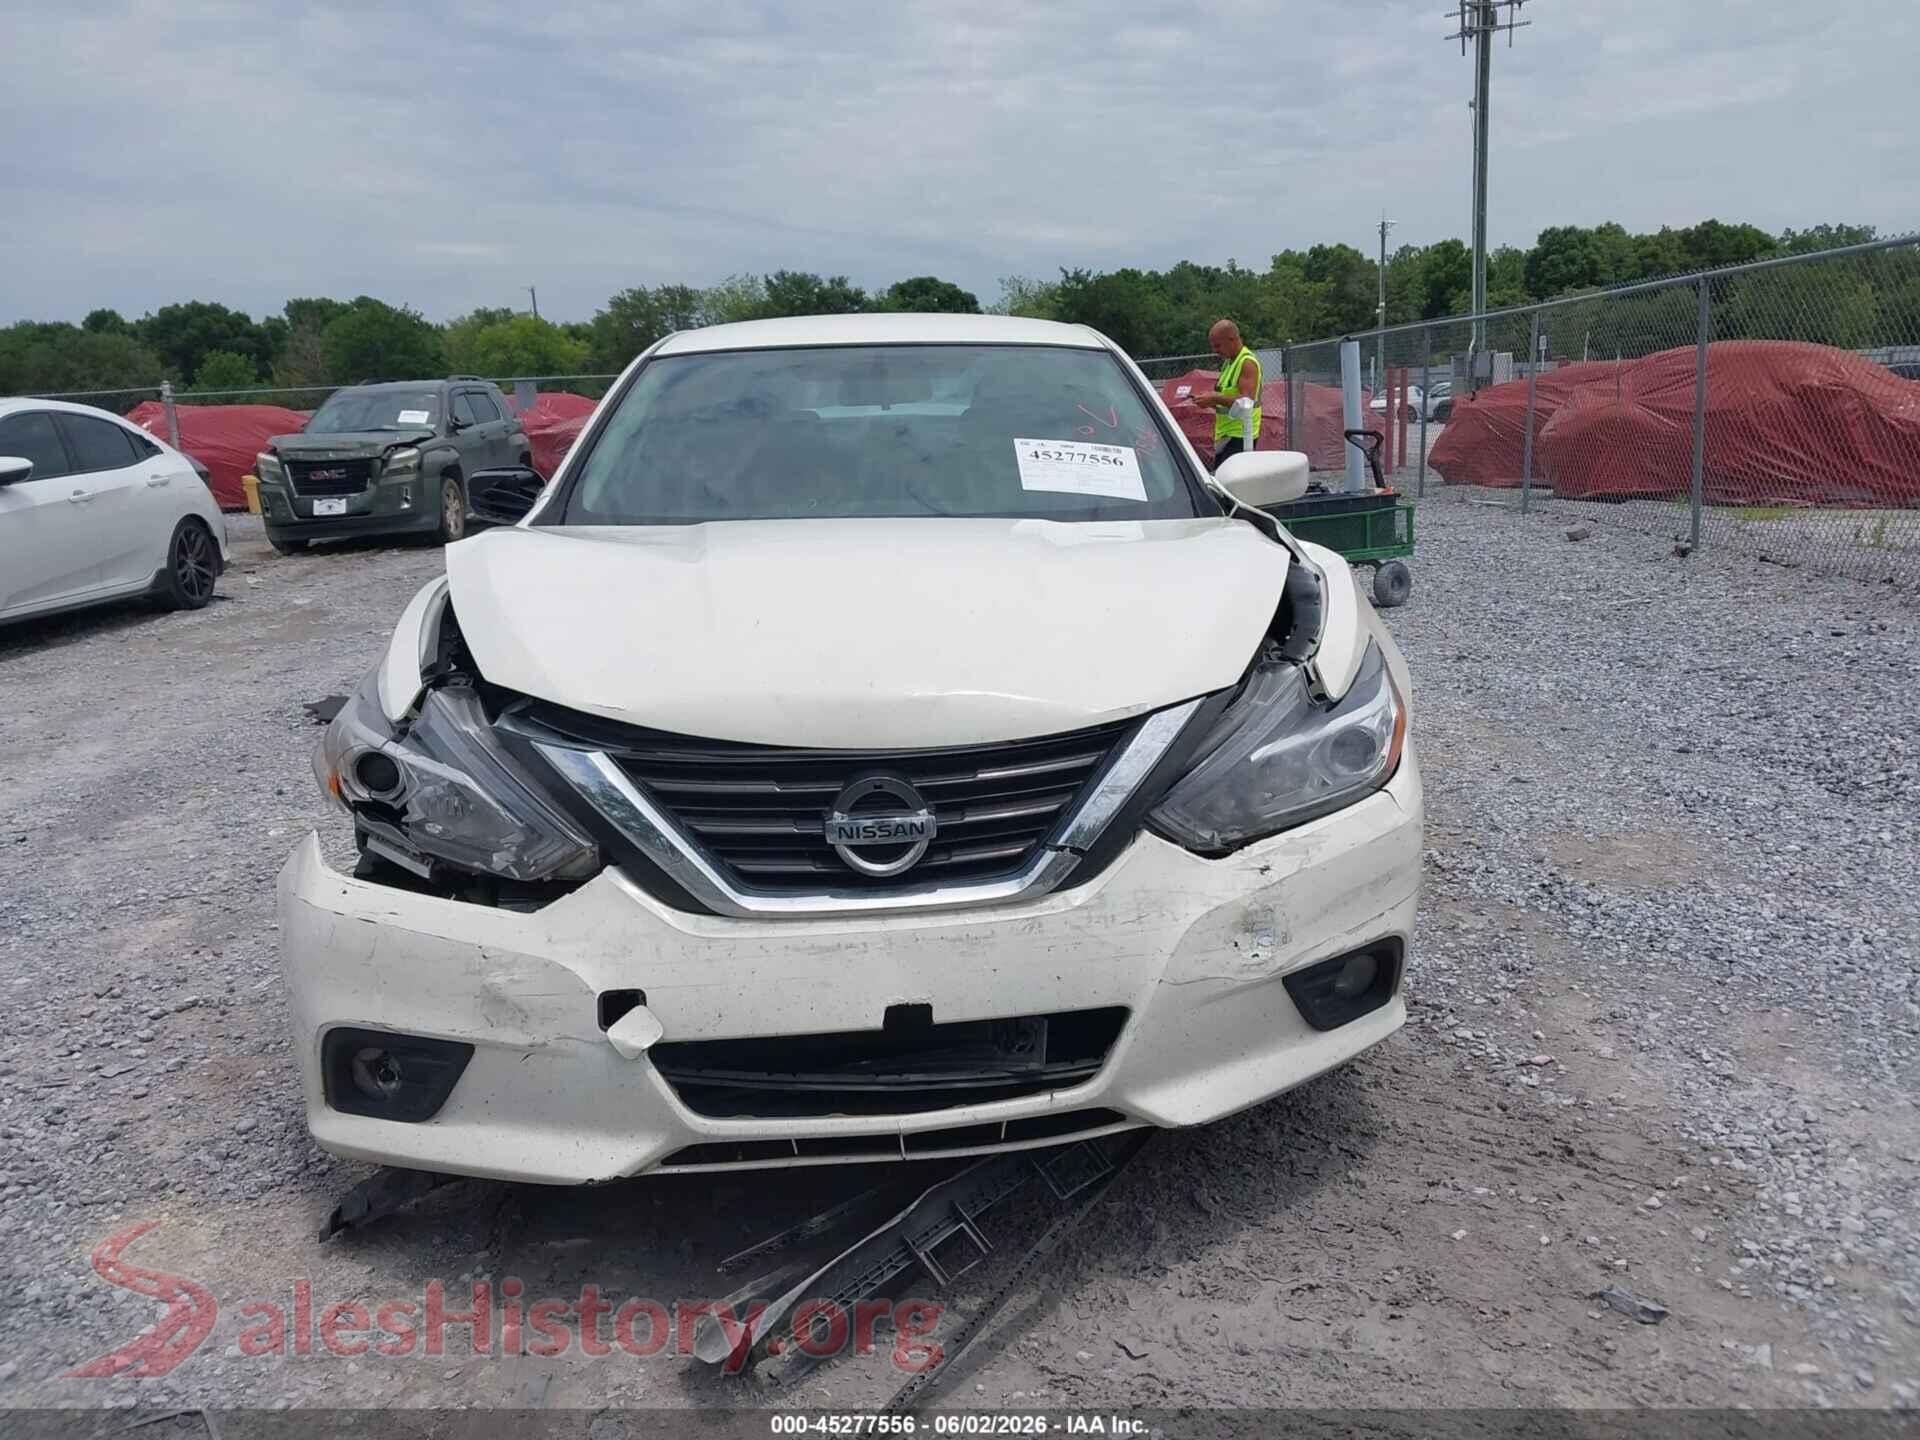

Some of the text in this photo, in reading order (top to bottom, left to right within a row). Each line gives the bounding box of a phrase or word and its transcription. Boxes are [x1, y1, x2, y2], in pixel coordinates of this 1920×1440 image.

[1029, 449, 1124, 467] 45277556
[310, 468, 347, 480] GMC
[837, 821, 925, 840] NISSAN
